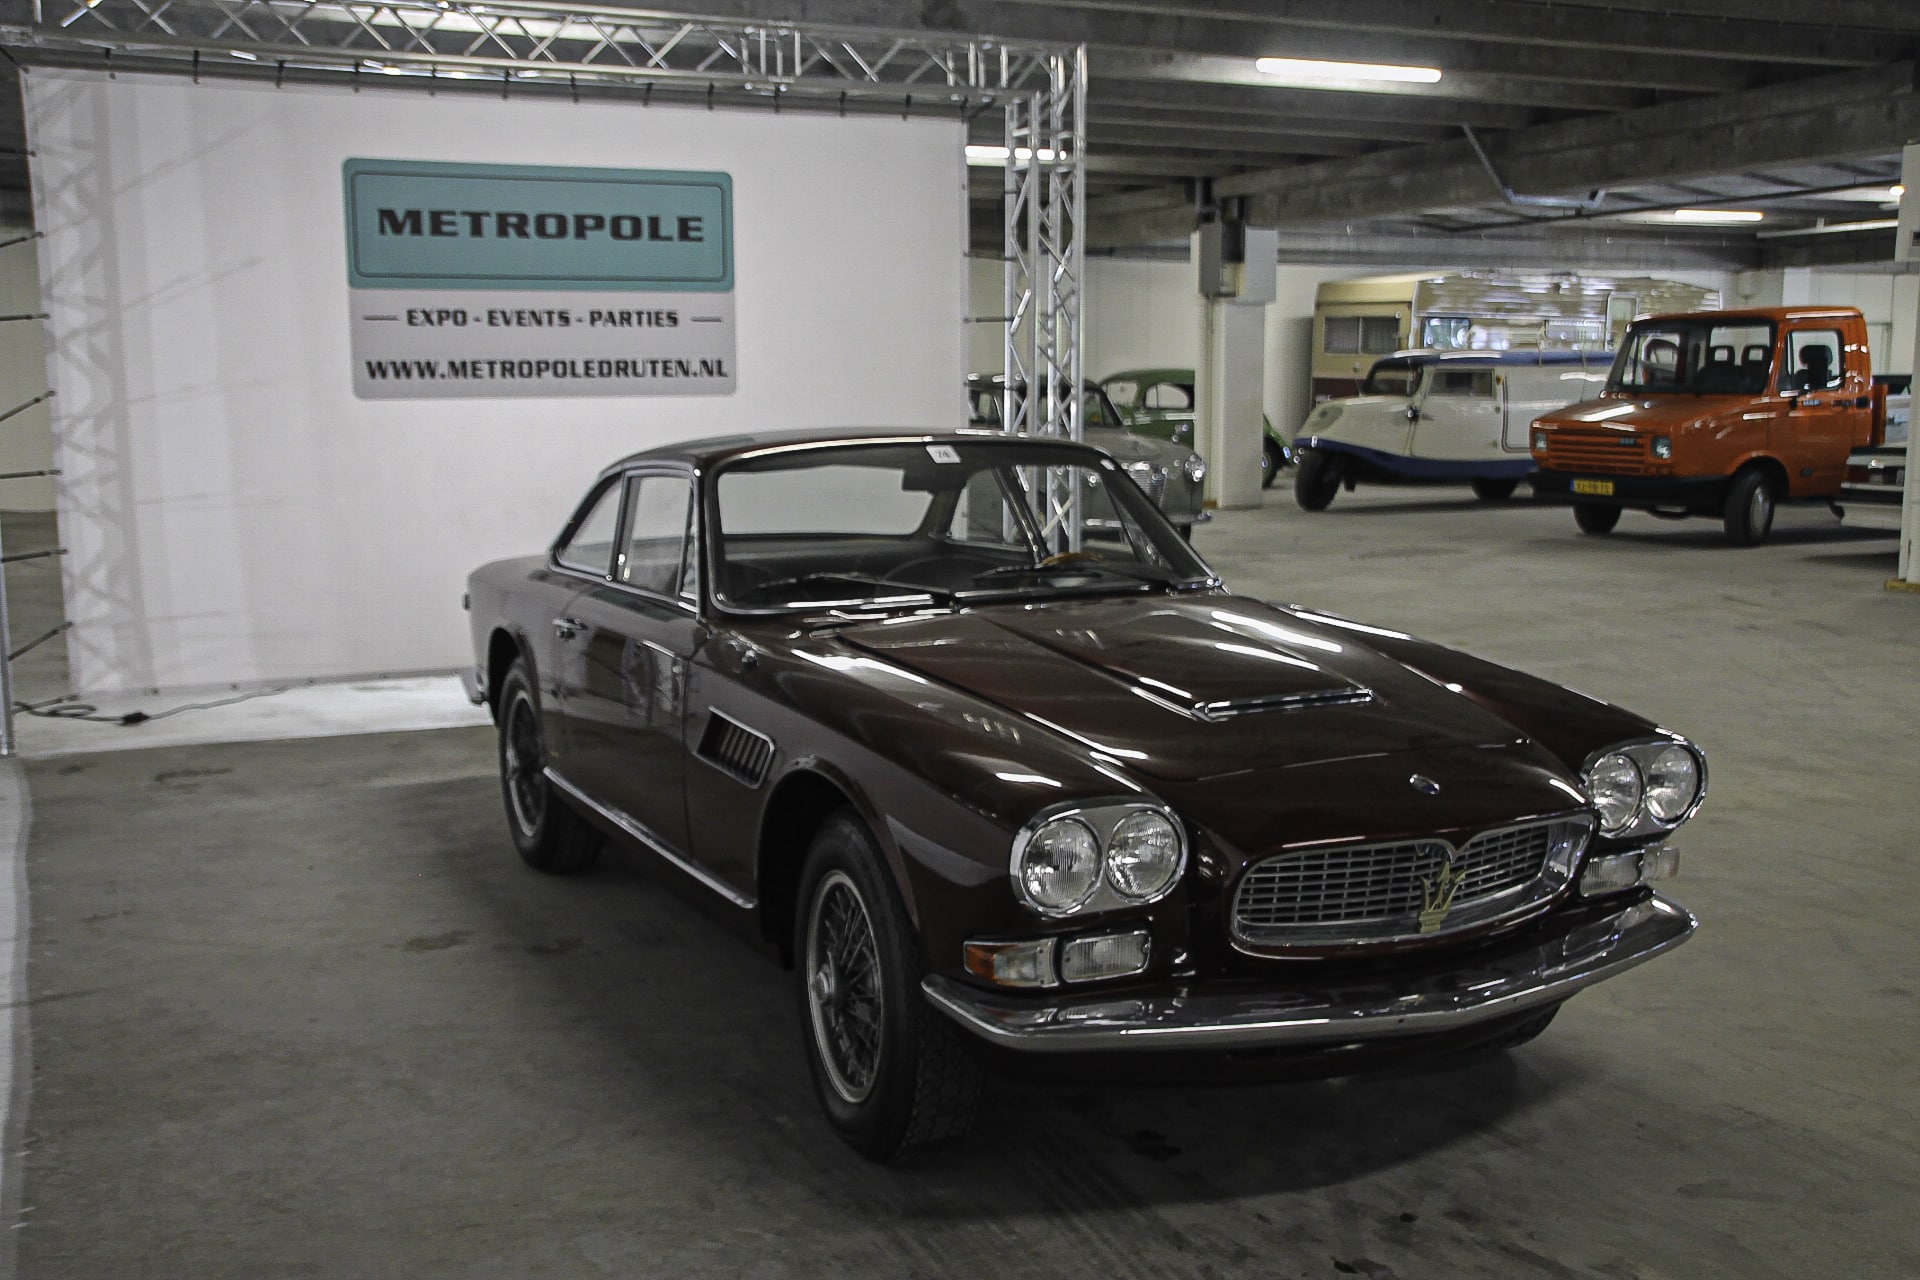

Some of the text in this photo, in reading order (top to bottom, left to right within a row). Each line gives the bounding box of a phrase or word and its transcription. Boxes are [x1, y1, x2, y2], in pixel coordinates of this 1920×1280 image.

[376, 207, 704, 242] METROPOLE
[405, 308, 468, 327] EXPO
[486, 308, 571, 327] EVENTS
[588, 309, 679, 328] PARTIES
[364, 358, 729, 380] WWW.METROPOLEDRUTEN.NL
